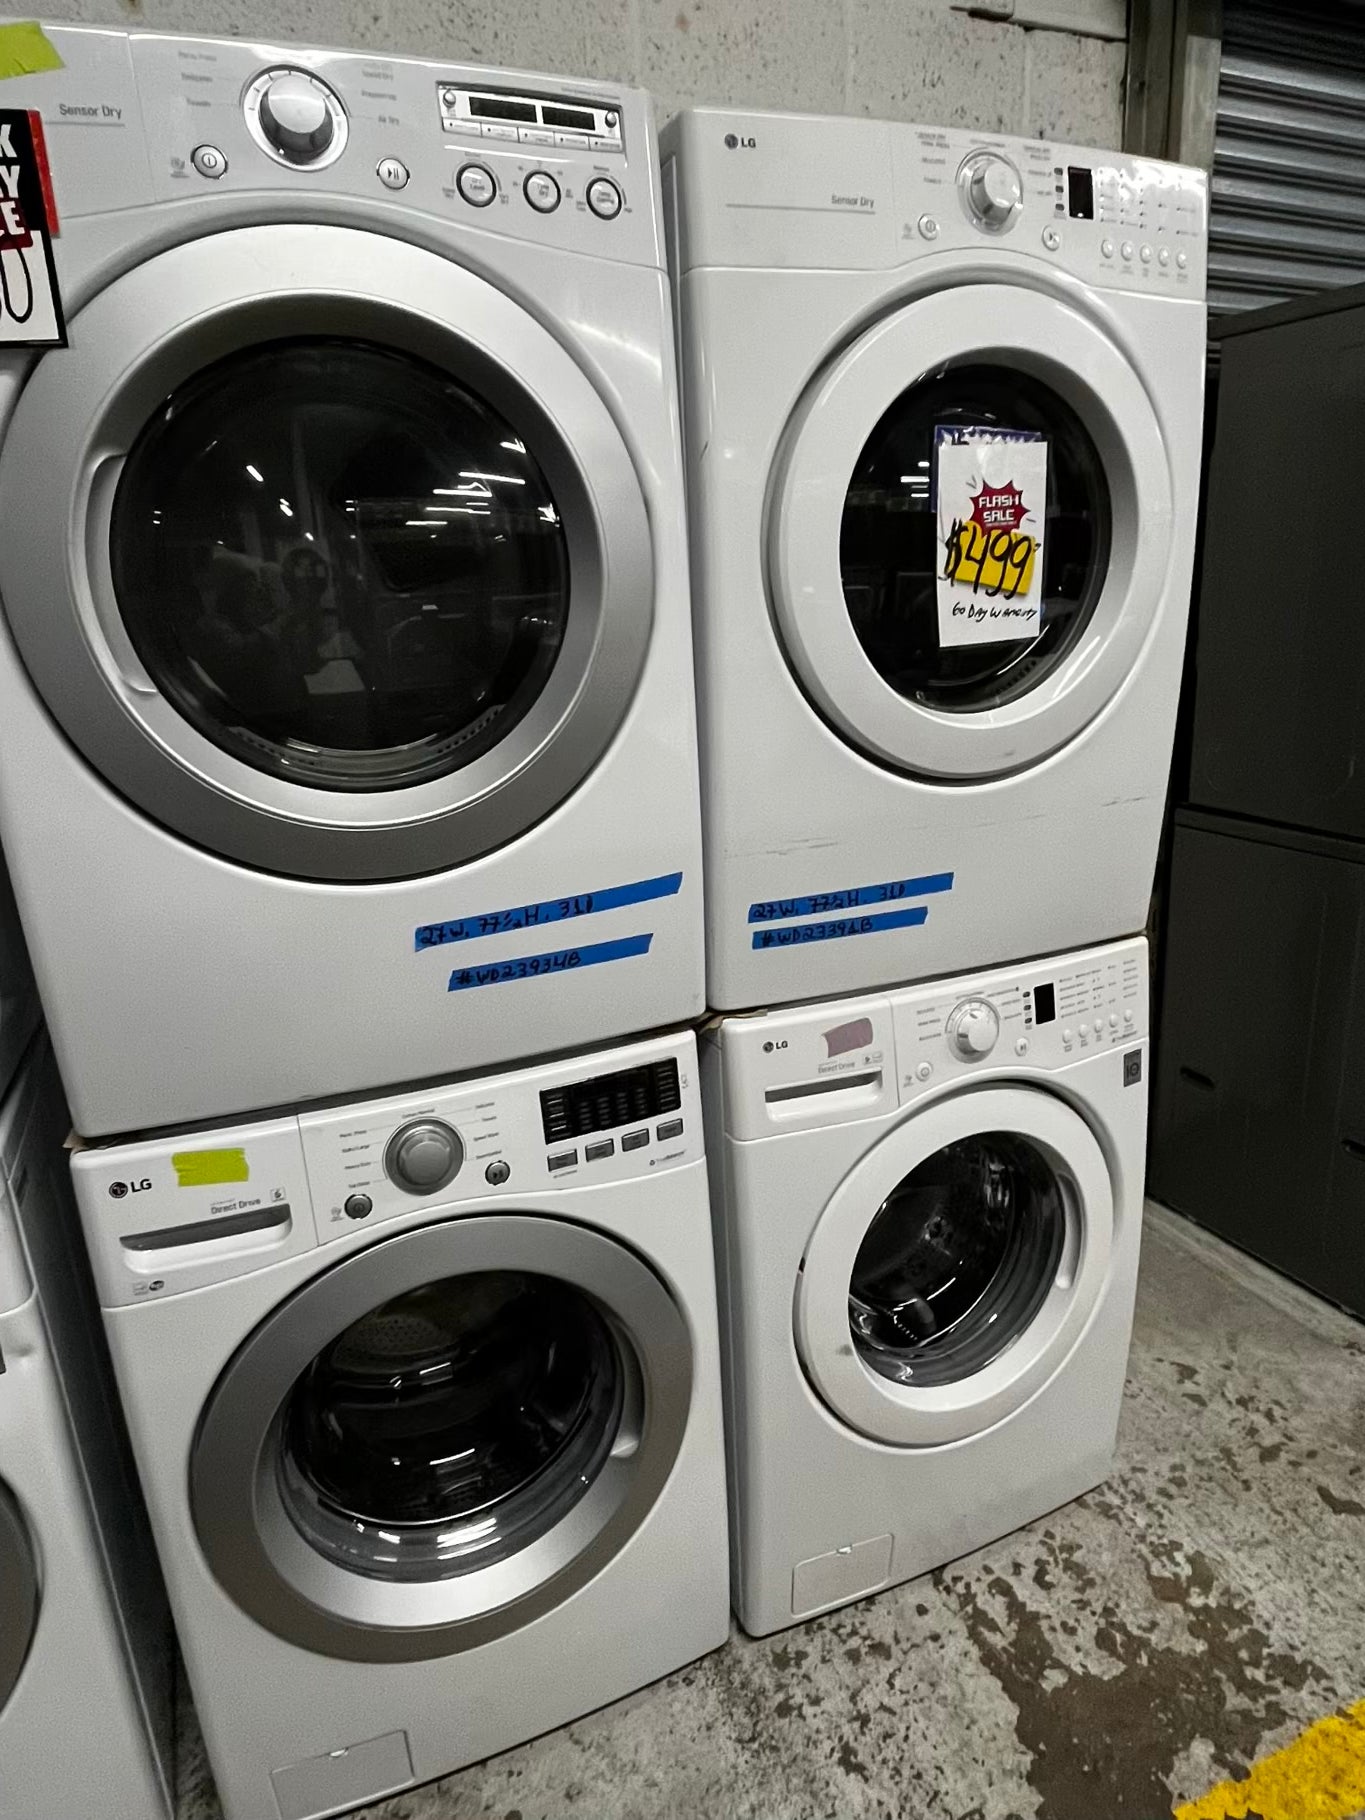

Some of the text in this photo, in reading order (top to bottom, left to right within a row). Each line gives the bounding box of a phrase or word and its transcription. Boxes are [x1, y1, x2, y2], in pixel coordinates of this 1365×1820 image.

[58, 103, 122, 120] Sensor Dry
[741, 137, 757, 149] LG
[831, 194, 875, 209] Sensor Dry
[978, 494, 1020, 509] FLASH
[983, 508, 1015, 523] SALE
[130, 1178, 152, 1194] LG
[210, 1202, 237, 1215] Direct
[238, 1197, 262, 1210] Drive
